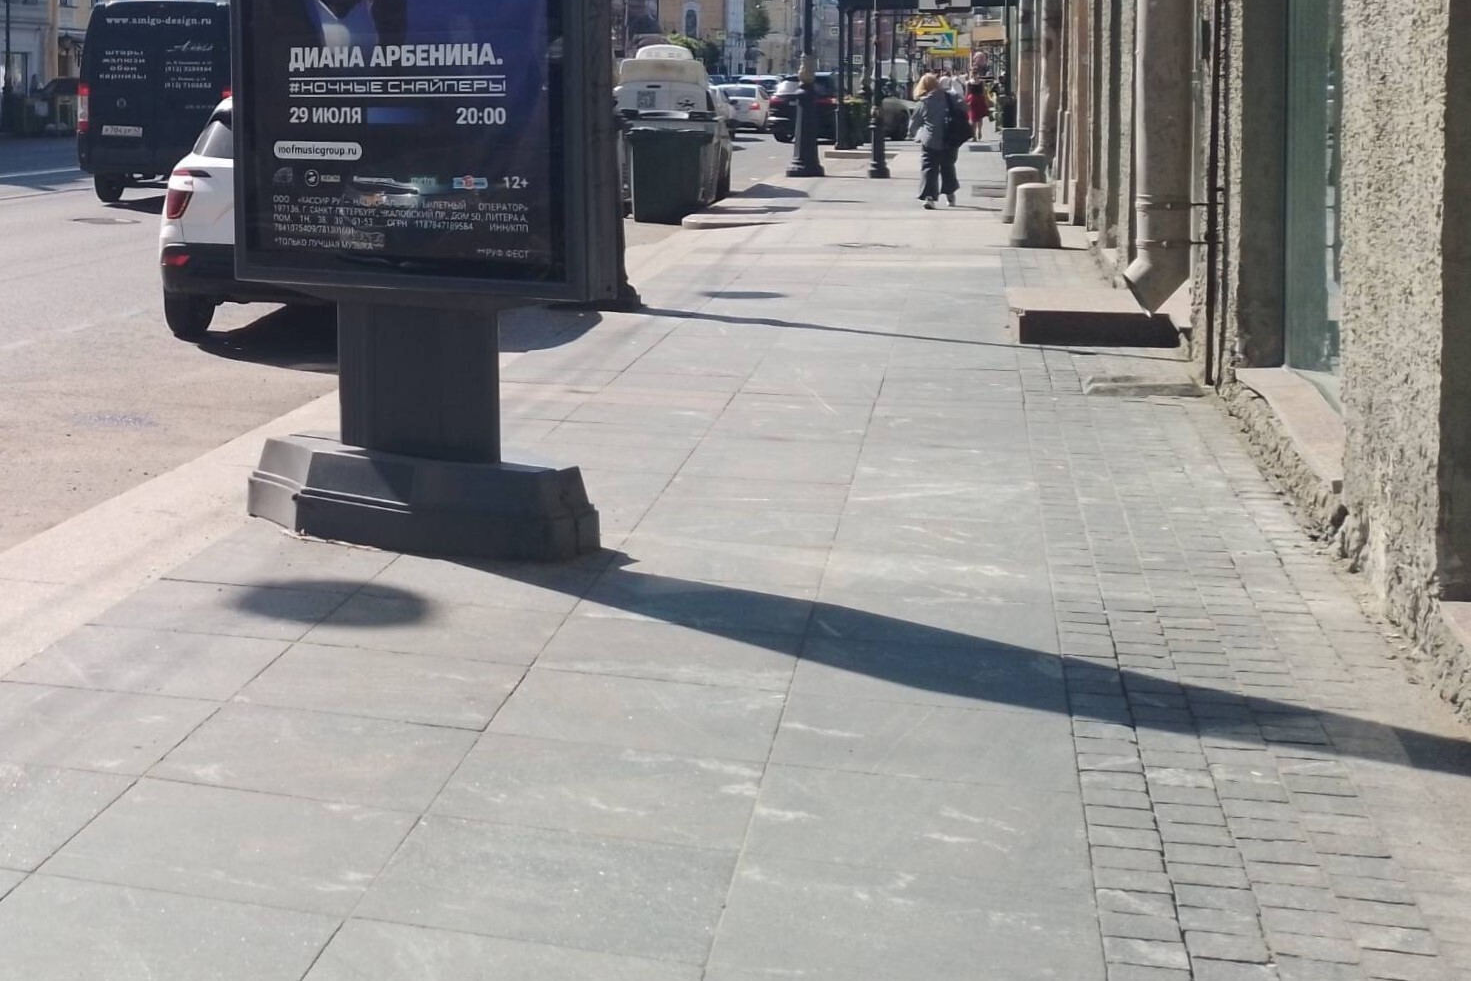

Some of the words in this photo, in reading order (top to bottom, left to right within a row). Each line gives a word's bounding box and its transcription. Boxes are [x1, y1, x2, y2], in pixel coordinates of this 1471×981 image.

[289, 46, 365, 72] ДИАНА
[369, 43, 503, 67] АРБЕНИНА.
[289, 81, 383, 93] #НОЧНЫЕ
[387, 79, 506, 93] СНАЙПЕРЫ
[289, 107, 308, 124] 29
[312, 107, 362, 124] ИЮЛЯ
[456, 107, 506, 125] 20:00
[278, 144, 357, 157] roofmusicgroup.ru
[502, 176, 529, 189] 12+
